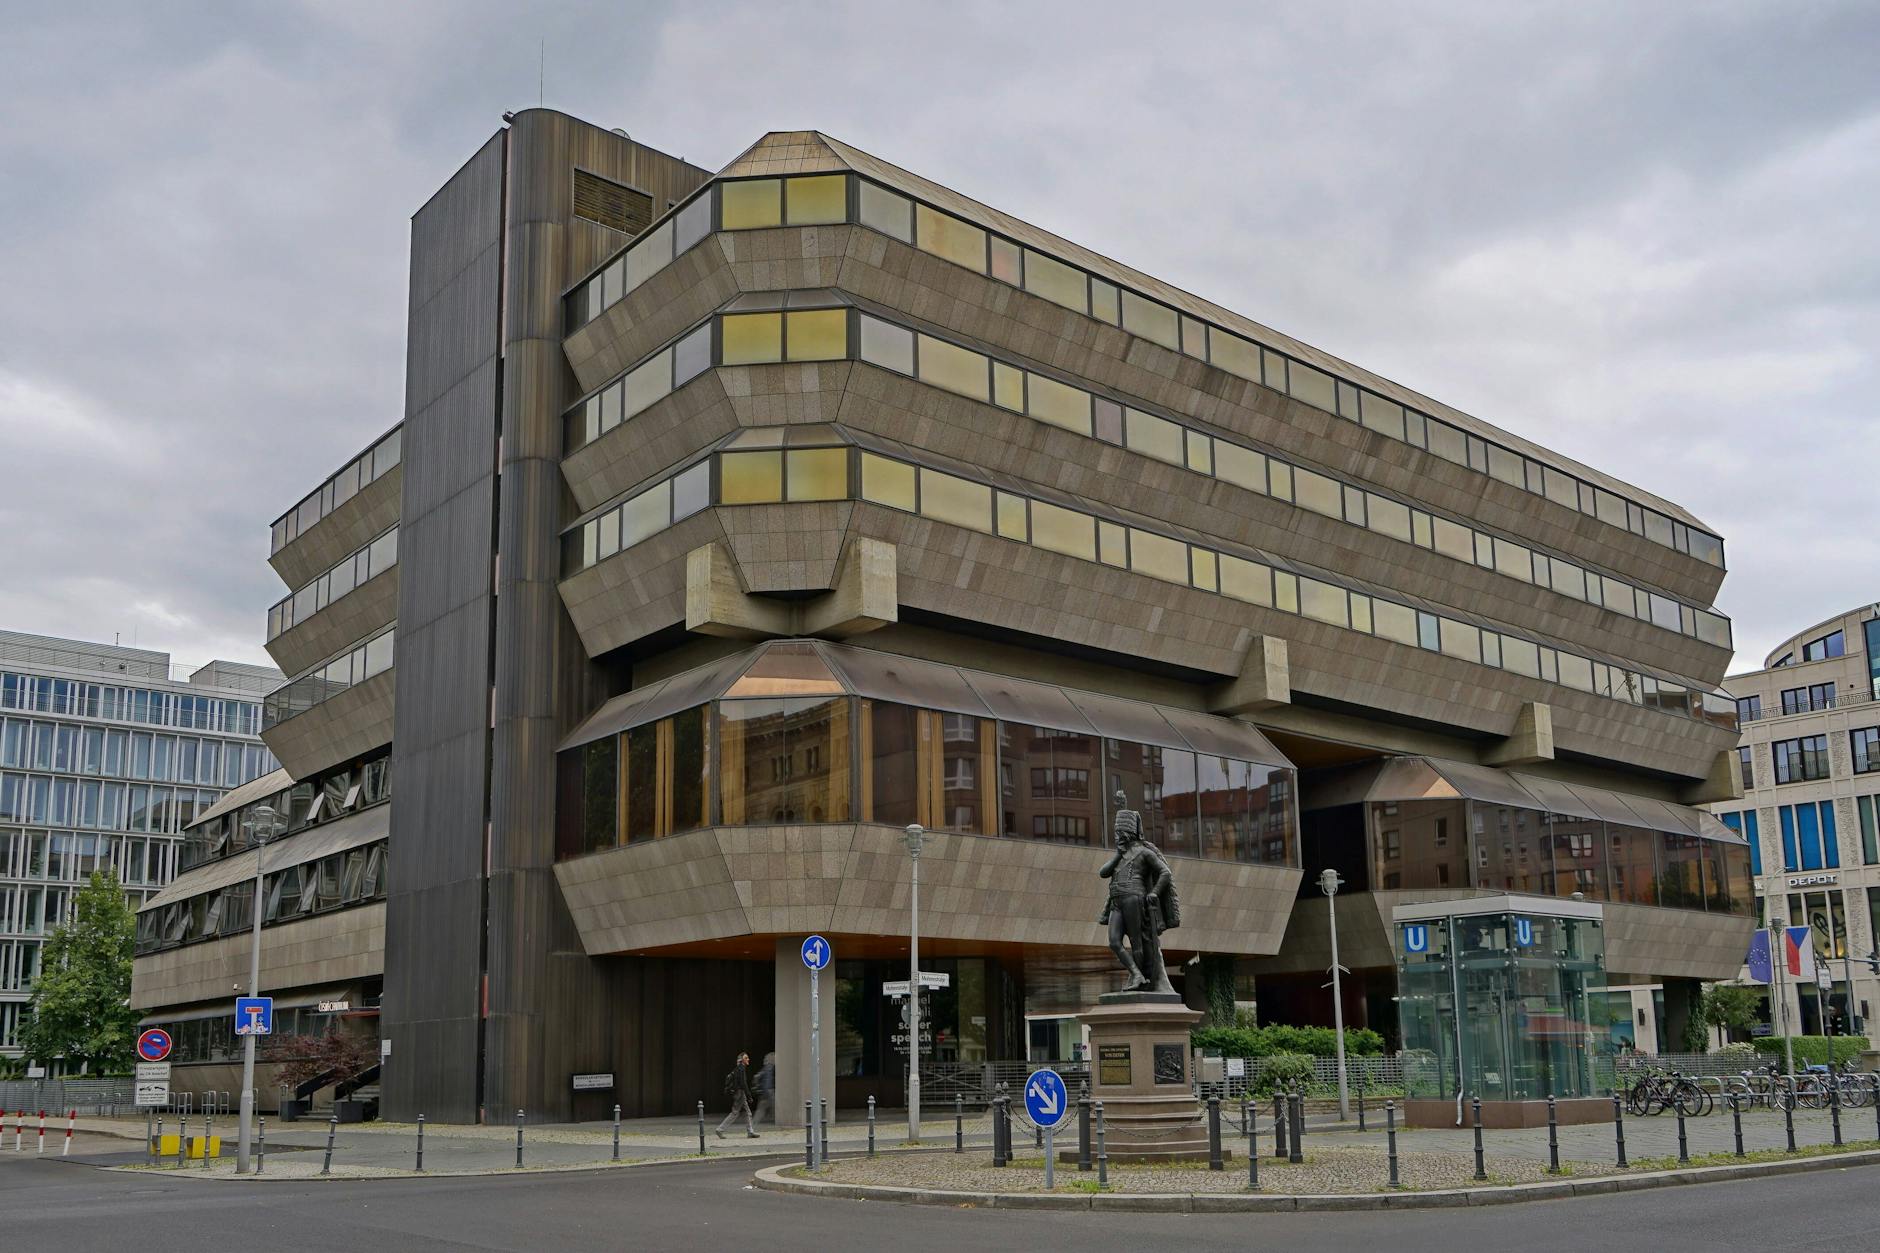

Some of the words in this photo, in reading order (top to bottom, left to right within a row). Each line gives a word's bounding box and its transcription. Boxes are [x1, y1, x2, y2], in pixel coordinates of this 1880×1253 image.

[1407, 926, 1425, 951] U
[1518, 920, 1531, 945] U
[891, 994, 930, 1005] manel
[898, 1021, 931, 1030] soer
[891, 1031, 931, 1045] spech
